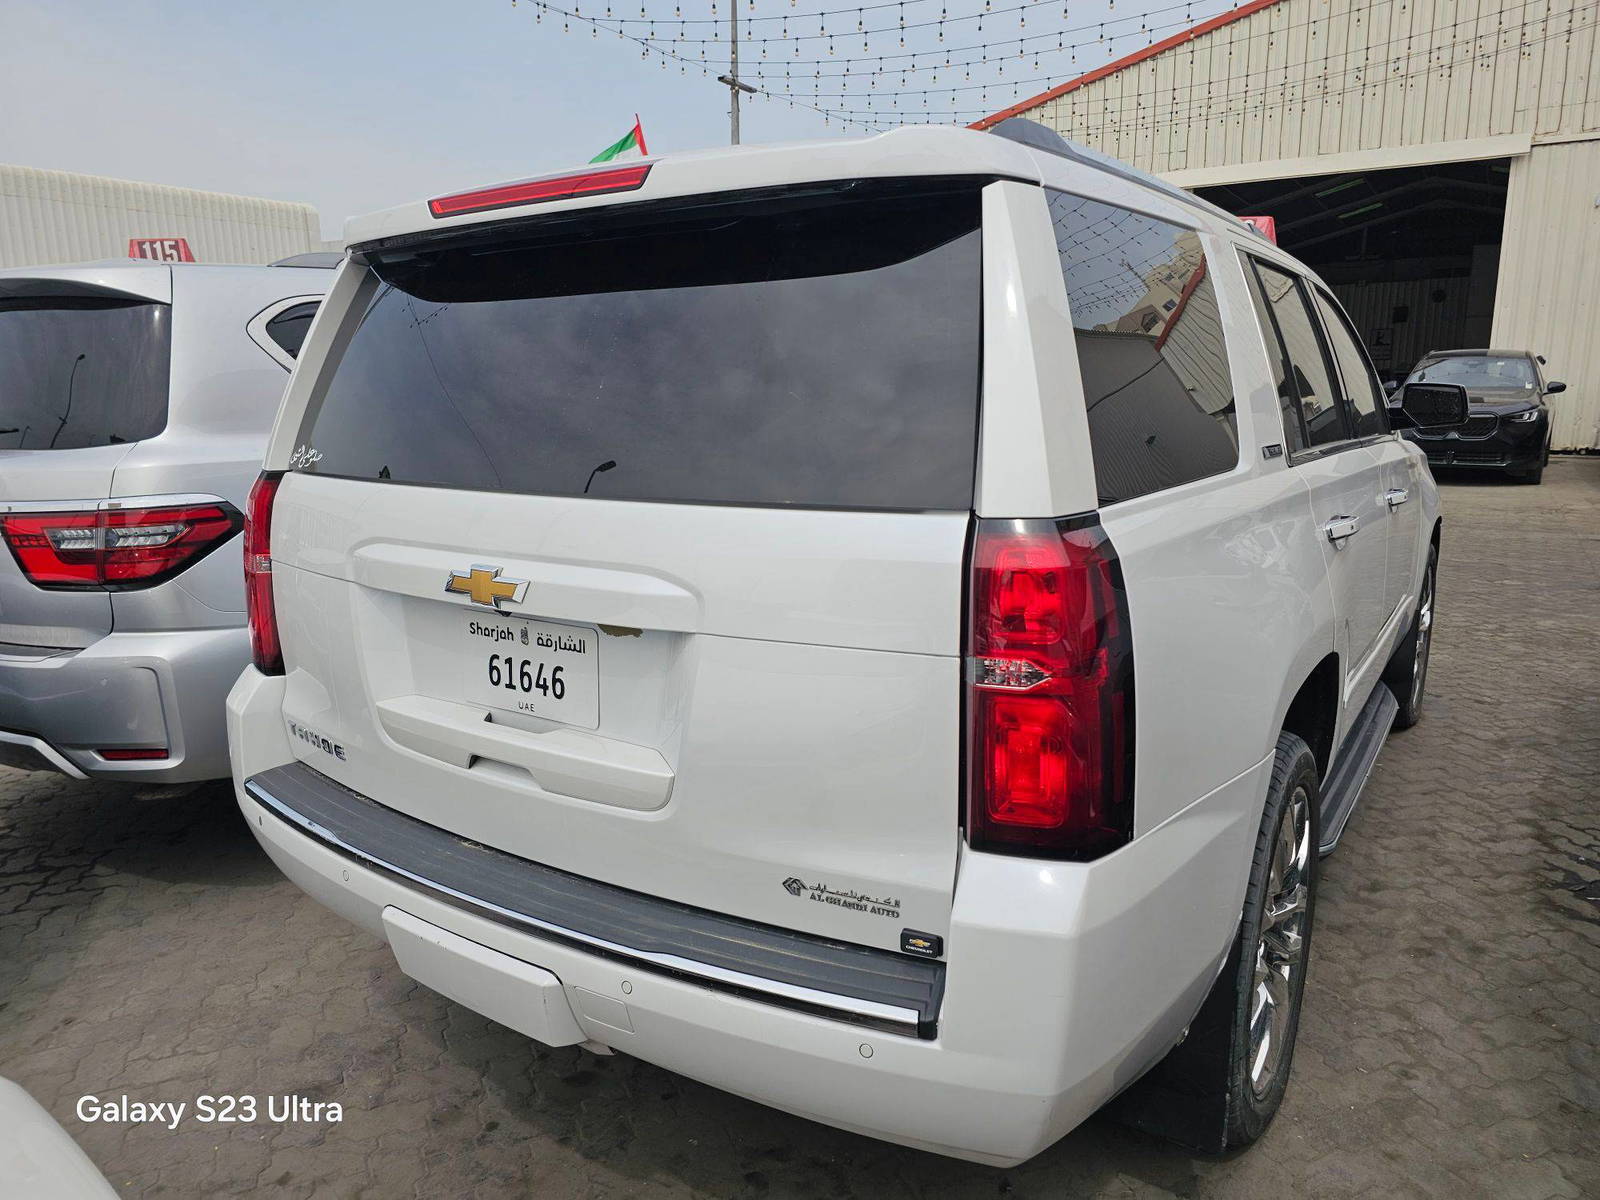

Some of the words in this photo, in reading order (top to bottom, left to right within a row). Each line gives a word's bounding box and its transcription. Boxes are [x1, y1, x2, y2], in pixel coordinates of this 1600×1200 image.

[142, 240, 179, 262] 115
[469, 621, 515, 642] Sharjah
[536, 632, 587, 654] الشارقة
[488, 653, 566, 700] 61646
[518, 701, 535, 713] UAE
[869, 905, 900, 918] AUTO
